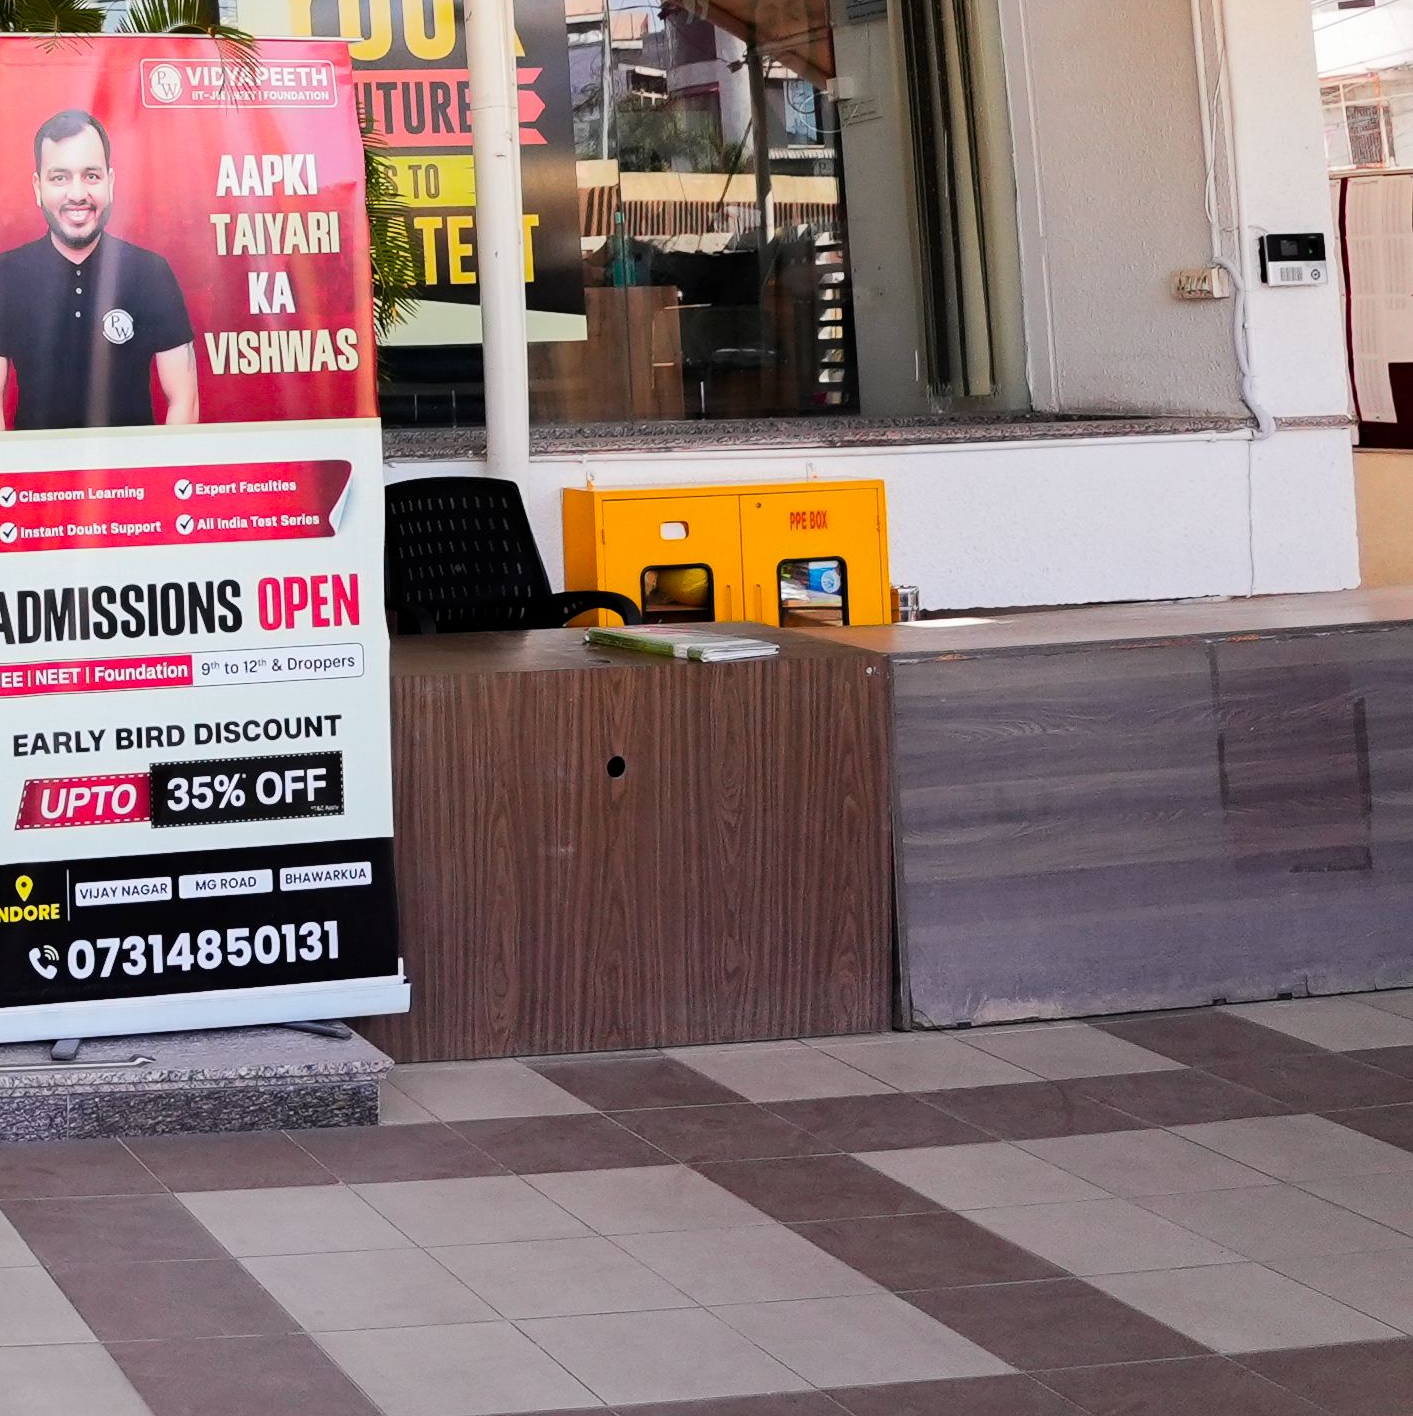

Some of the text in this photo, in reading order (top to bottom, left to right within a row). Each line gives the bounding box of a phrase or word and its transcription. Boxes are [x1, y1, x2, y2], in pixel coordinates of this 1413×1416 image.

[186, 66, 327, 87] VIDYAPEETH
[263, 91, 329, 100] FOUNDATION
[354, 81, 472, 134] UTURE
[216, 153, 317, 197] AAPKI
[408, 163, 440, 200] TO
[210, 211, 340, 256] TAIYARI
[249, 271, 296, 315] KA
[204, 328, 359, 375] VISHWAS
[19, 486, 144, 503] Classroom Learning
[195, 480, 296, 496] Expert Faculties
[20, 520, 161, 538] Instant Doubt Support
[197, 514, 319, 530] All India Test Series
[790, 511, 828, 531] PPE BOX
[258, 574, 360, 631] OPEN
[35, 668, 81, 685] NEET
[94, 663, 188, 682] Foundation
[225, 662, 239, 675] to
[272, 658, 283, 672] &
[287, 654, 355, 674] Droppers
[13, 714, 342, 757] EARLY BIRD DISCOUNT
[40, 784, 137, 820] UPTO
[256, 768, 326, 805] OFF
[195, 877, 257, 891] MG ROAD
[285, 868, 367, 885] BHAWARKUA
[79, 882, 168, 900] VIJAY NAGAR
[68, 920, 338, 980] 07314850131
